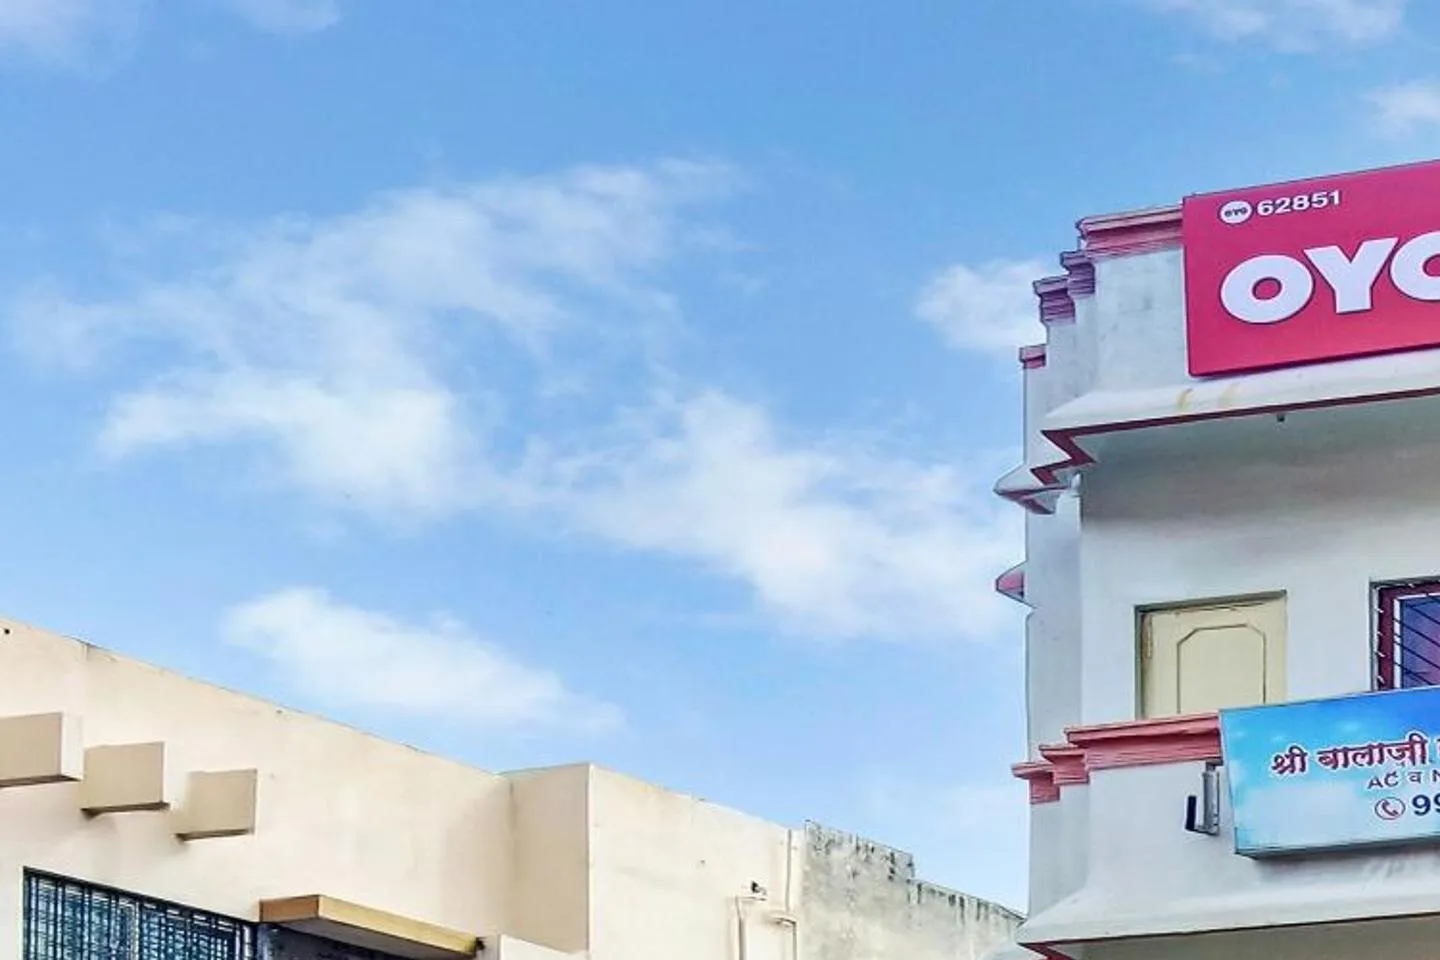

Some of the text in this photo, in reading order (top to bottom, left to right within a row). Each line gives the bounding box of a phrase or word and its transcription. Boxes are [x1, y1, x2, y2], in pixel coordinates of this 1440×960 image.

[1256, 189, 1340, 216] 62851
[1270, 744, 1308, 776] श्री
[1317, 732, 1430, 771] बालाजी
[1366, 771, 1399, 790] AC
